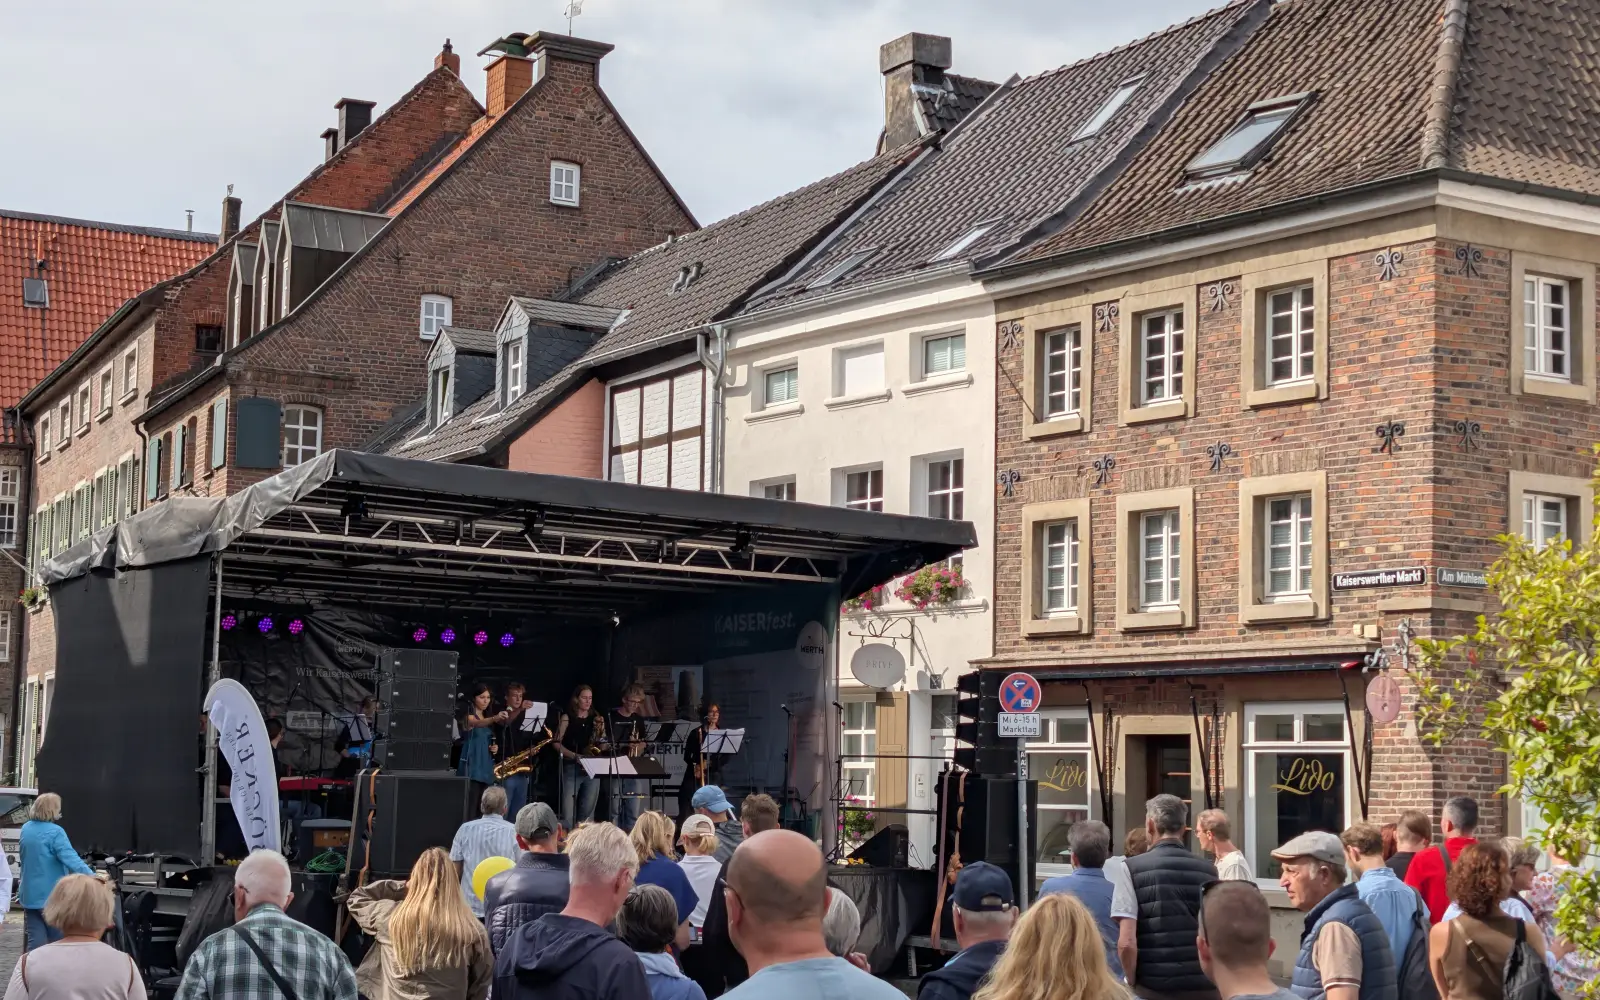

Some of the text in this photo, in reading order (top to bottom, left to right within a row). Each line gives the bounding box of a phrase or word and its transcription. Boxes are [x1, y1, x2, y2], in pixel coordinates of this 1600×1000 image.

[1336, 570, 1422, 587] Kaiserswerther Markt
[1441, 570, 1454, 582] Am
[800, 644, 824, 655] WERTH
[295, 667, 313, 677] Wir
[1002, 715, 1012, 724] Mi
[1032, 715, 1037, 724] h
[1002, 725, 1037, 735] Markttag
[1038, 758, 1087, 792] Lido
[1269, 757, 1335, 795] Lido
